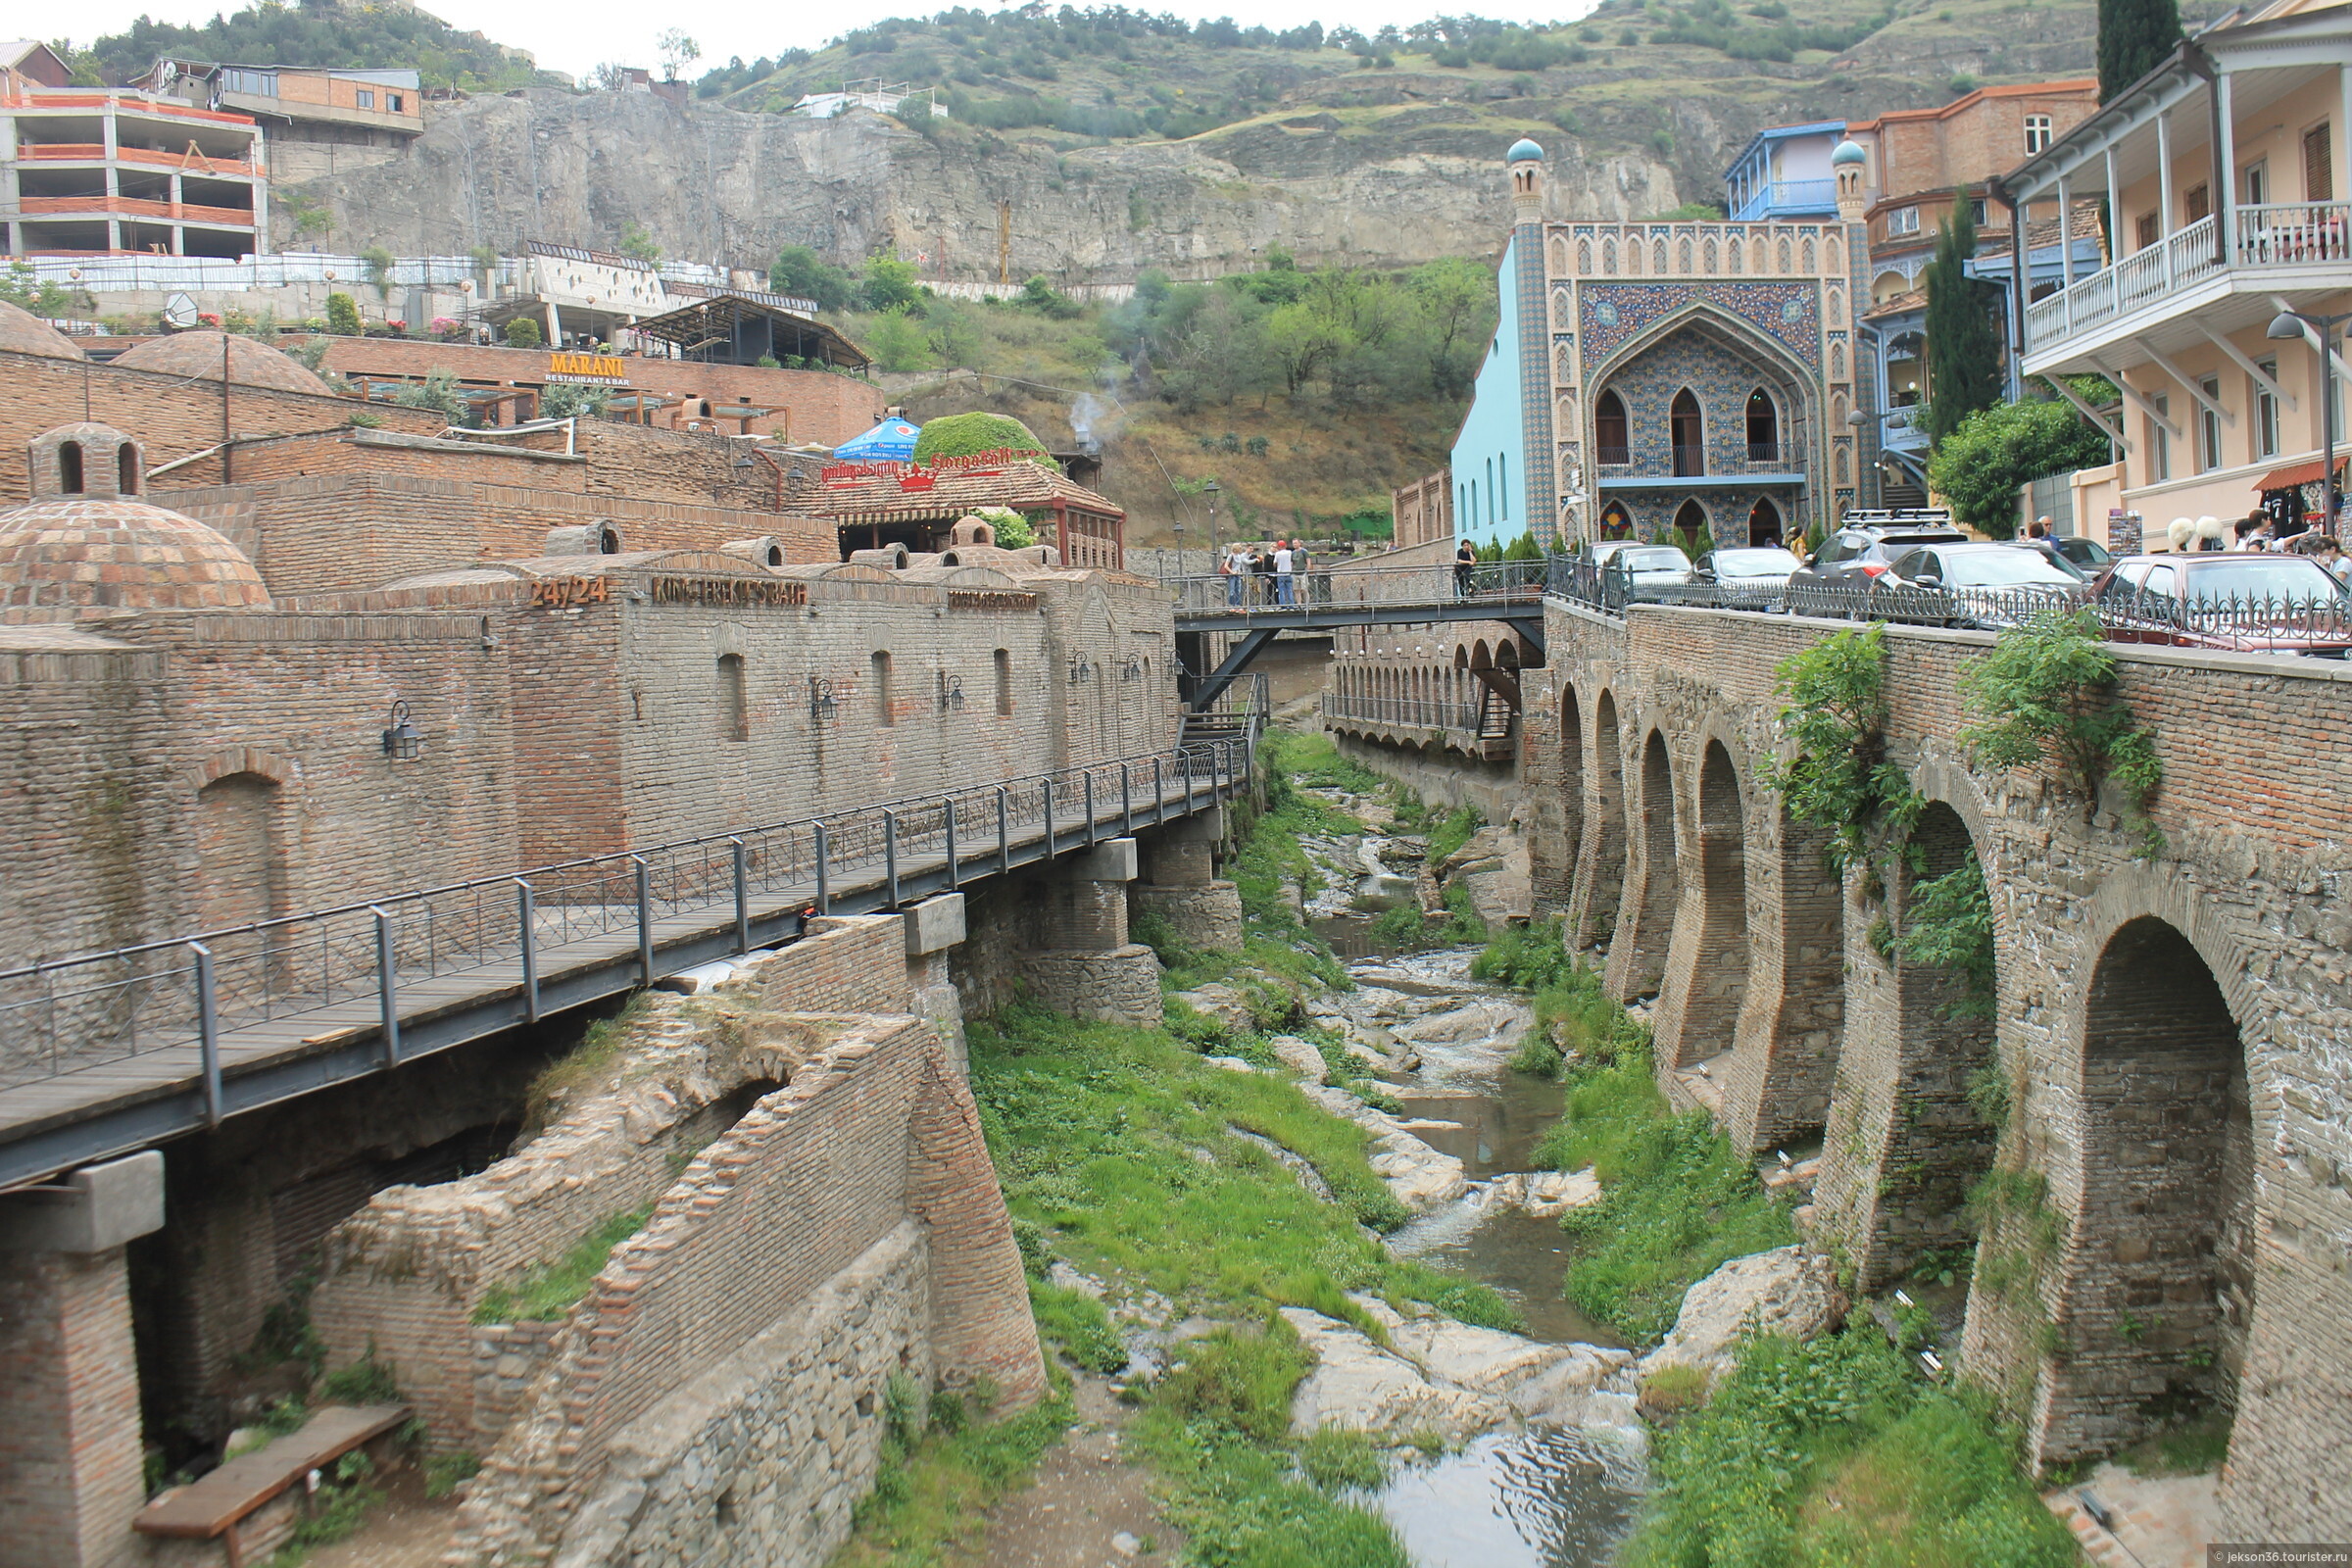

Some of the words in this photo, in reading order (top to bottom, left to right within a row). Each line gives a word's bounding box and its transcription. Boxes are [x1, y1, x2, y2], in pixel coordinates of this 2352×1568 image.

[550, 353, 623, 377] MARANI
[545, 373, 605, 384] RESTAURANT
[529, 575, 608, 608] 24/24
